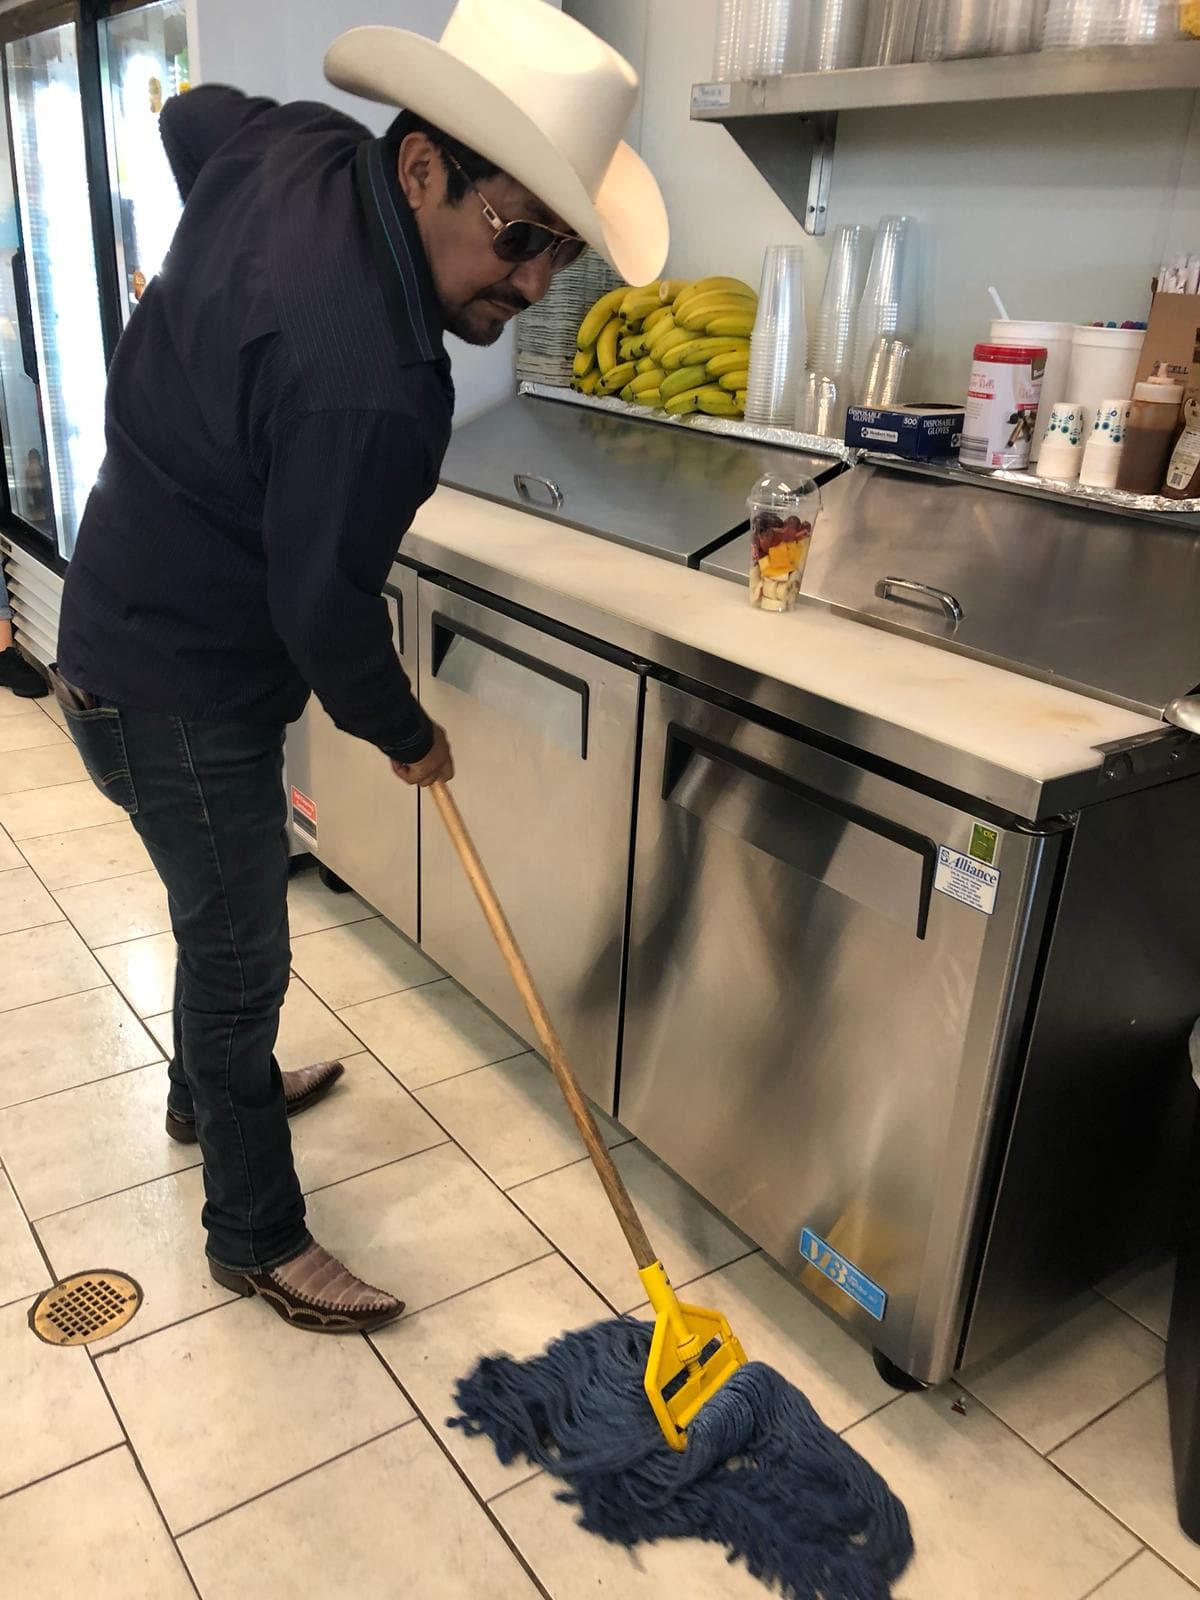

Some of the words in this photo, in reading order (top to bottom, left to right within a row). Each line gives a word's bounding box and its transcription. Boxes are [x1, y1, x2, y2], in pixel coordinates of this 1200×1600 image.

[848, 408, 881, 419] DISPOSABLE
[852, 416, 875, 424] GLOVES
[903, 417, 918, 426] 500
[923, 418, 956, 428] DISPOSABLE
[927, 427, 950, 435] GLOVES
[949, 856, 997, 884] Alliance
